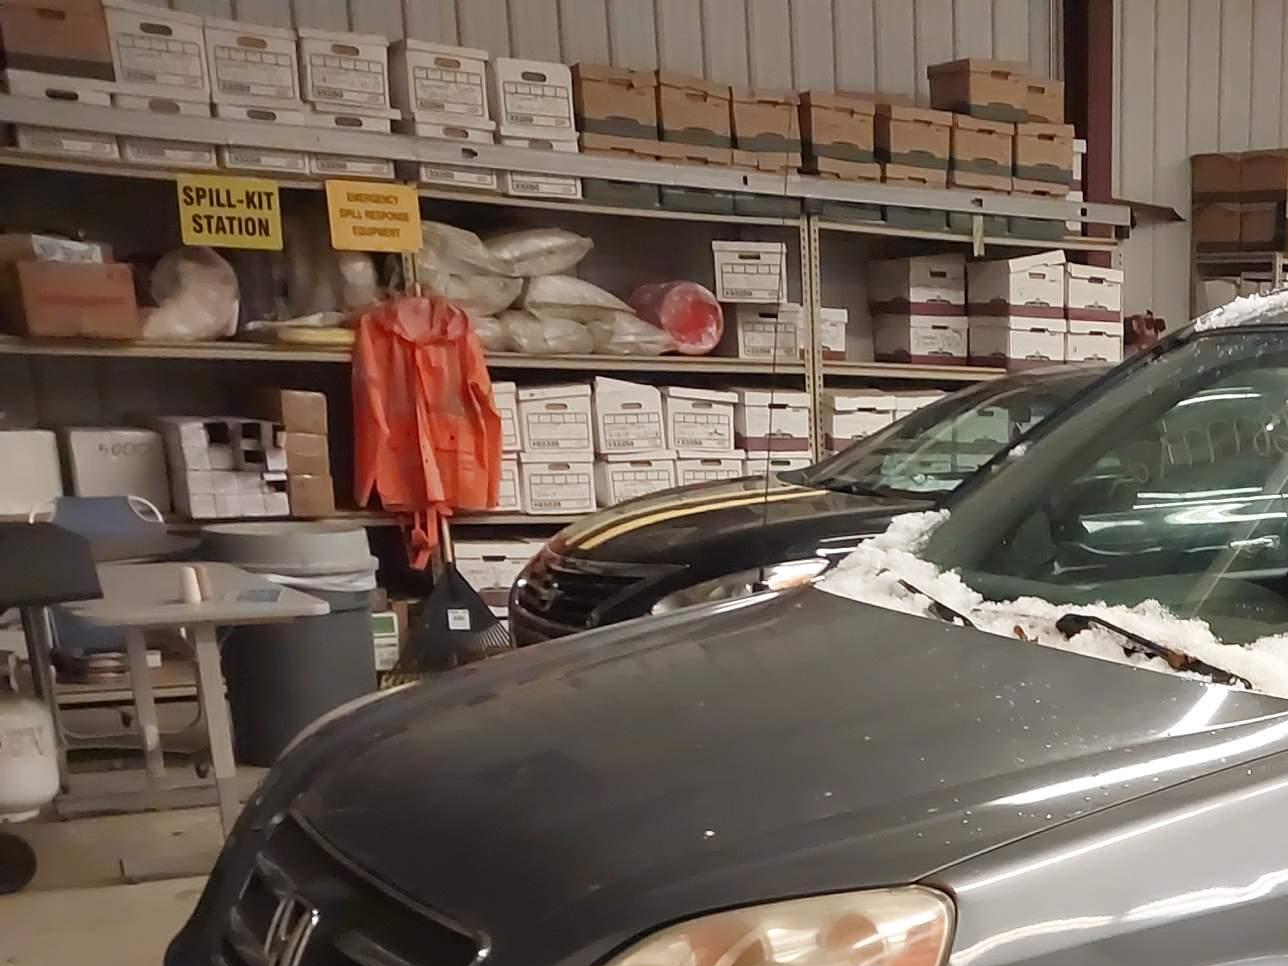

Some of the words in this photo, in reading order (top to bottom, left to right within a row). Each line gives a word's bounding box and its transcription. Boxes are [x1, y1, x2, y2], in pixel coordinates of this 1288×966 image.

[182, 185, 275, 210] SPILL-KIT
[346, 192, 399, 205] EMERGENCY
[339, 208, 362, 221] SPILL
[364, 209, 410, 223] RESPONSE
[191, 214, 271, 237] STATION
[352, 226, 401, 239] EQUIPMENT
